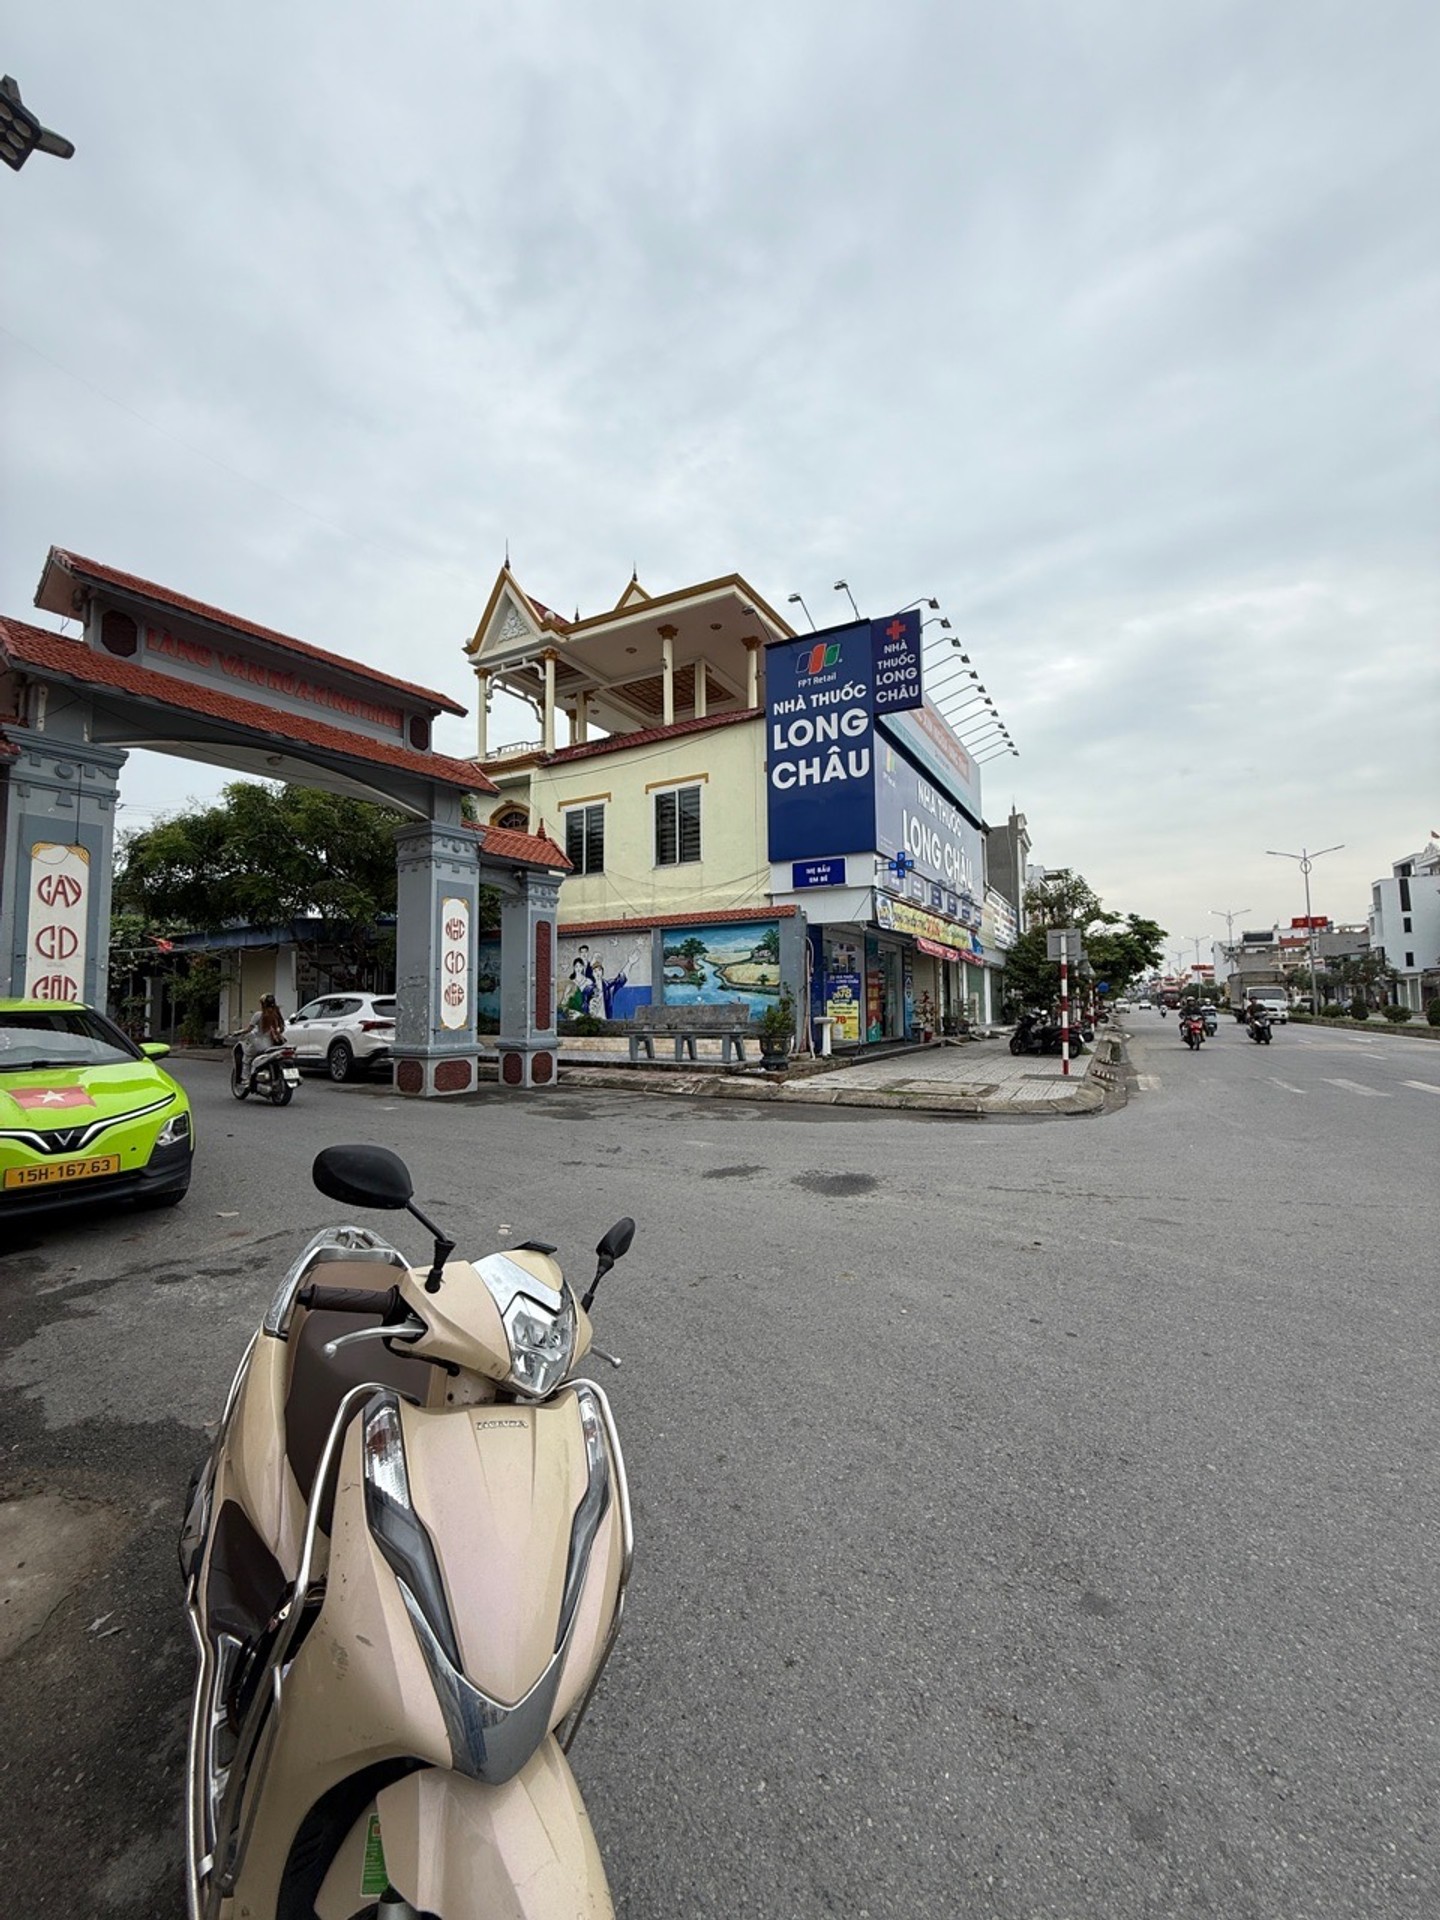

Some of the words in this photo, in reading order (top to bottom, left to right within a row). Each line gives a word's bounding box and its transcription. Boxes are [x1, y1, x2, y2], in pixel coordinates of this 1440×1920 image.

[146, 626, 213, 668] LÀNG
[216, 648, 267, 687] VĂN
[883, 638, 908, 654] NHÀ
[877, 651, 916, 670] THUỐC
[797, 677, 812, 688] FPT
[813, 672, 837, 685] Retail
[876, 667, 918, 686] LONG
[773, 694, 807, 716] NHÀ
[810, 680, 867, 708] THUỐC
[876, 684, 919, 703] CHÂU
[774, 707, 869, 751] LONG
[771, 745, 870, 790] CHÂU
[902, 808, 942, 870] LONG
[944, 842, 974, 891] CHÂU
[18, 1159, 111, 1184] 15H-167.63
